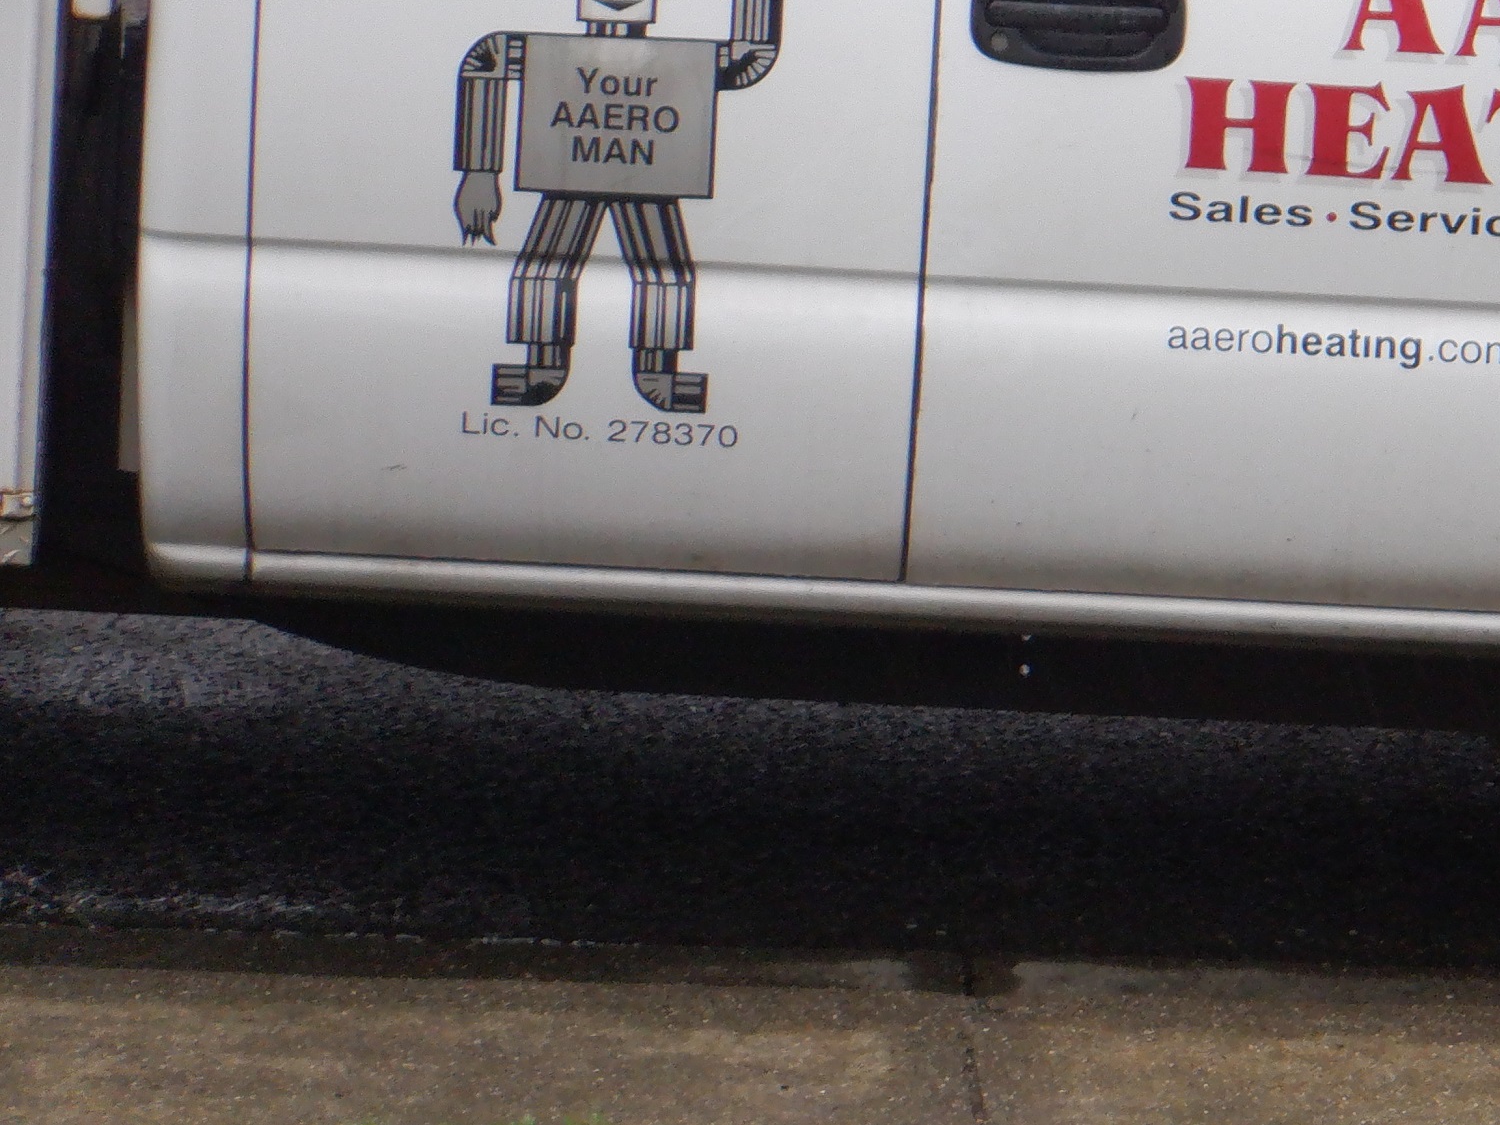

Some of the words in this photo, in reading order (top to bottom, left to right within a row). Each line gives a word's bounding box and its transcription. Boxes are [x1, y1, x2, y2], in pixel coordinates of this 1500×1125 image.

[576, 67, 658, 98] Your
[550, 101, 680, 134] AAERO
[571, 136, 656, 166] MAN
[1169, 192, 1313, 229] Sales
[461, 411, 520, 438] Lic.
[534, 416, 590, 442] No.
[607, 420, 739, 449] 278370
